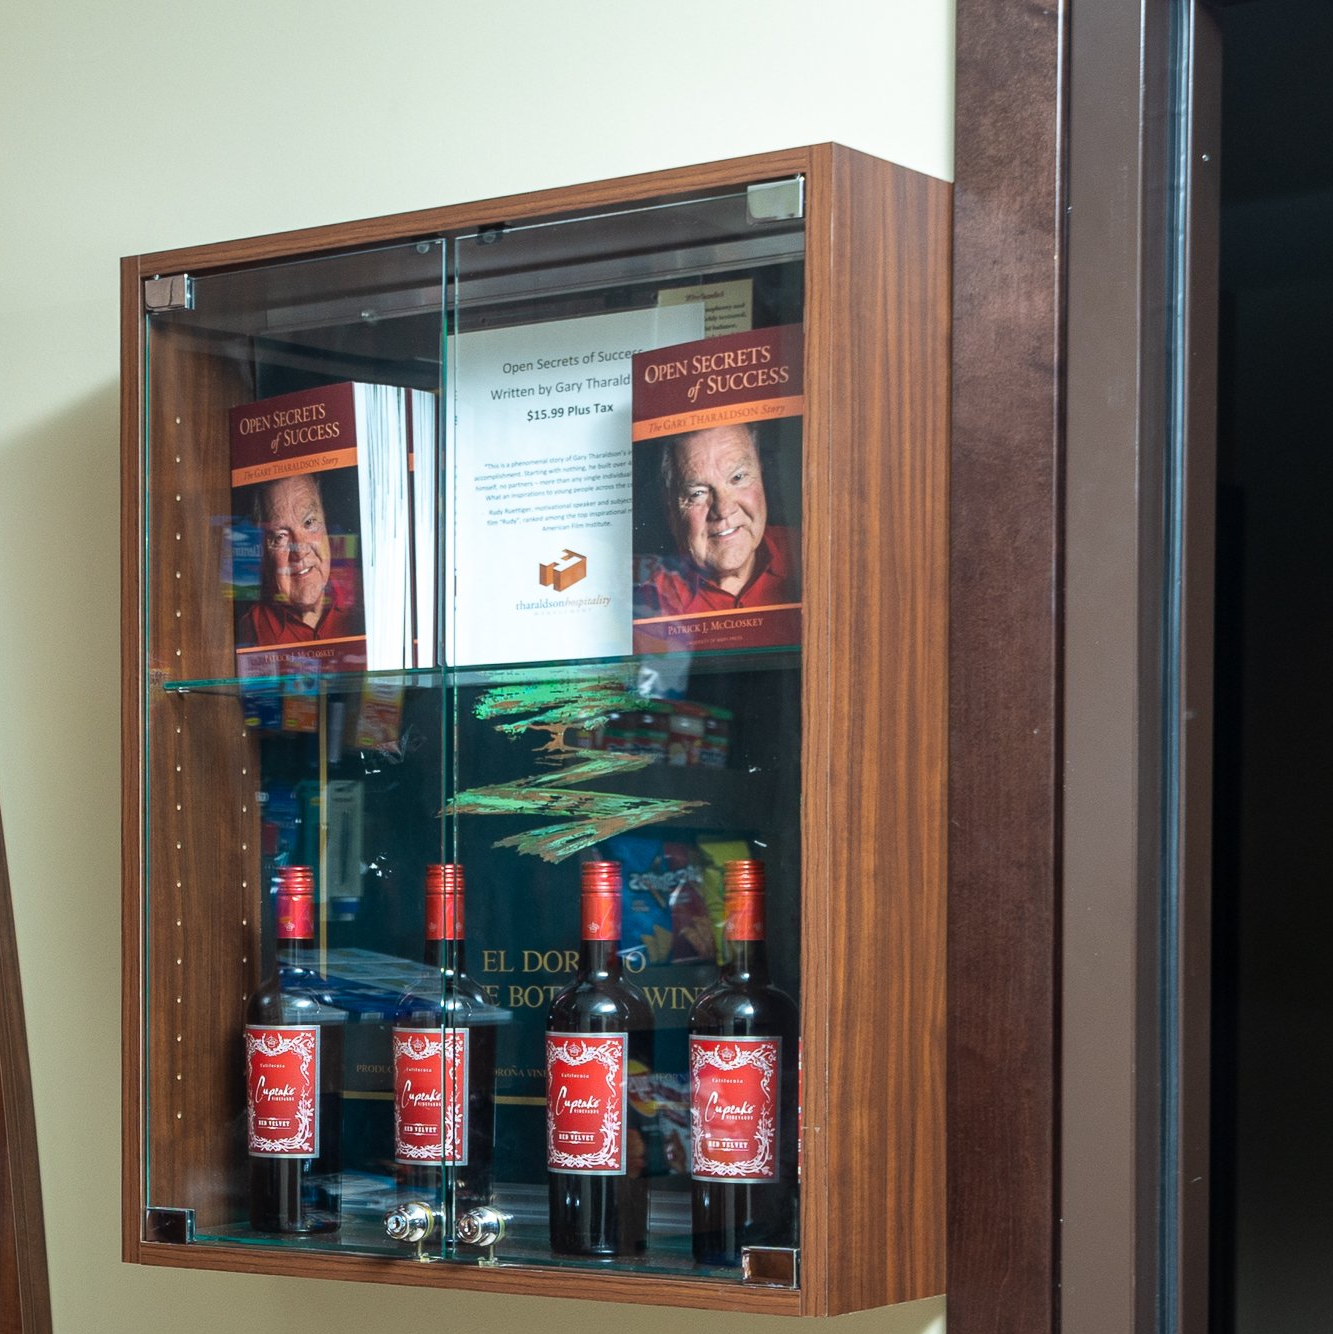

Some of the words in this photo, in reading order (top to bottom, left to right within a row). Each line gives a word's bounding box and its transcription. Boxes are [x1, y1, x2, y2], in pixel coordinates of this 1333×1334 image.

[502, 360, 534, 376] Open
[536, 355, 580, 371] Secrets
[582, 352, 596, 365] of
[644, 359, 689, 384] OPEN
[692, 345, 771, 375] SECRETS
[491, 385, 535, 401] Written
[538, 384, 553, 397] by
[555, 381, 584, 394] Gary
[586, 374, 631, 390] Tharald
[687, 378, 704, 403] of
[706, 366, 790, 395] SUCCESS
[239, 414, 271, 436] OPEN
[273, 403, 326, 429] SECRETS
[526, 407, 564, 422] $15.99
[567, 405, 591, 417] Plus
[593, 402, 614, 414] Tax
[648, 422, 662, 434] The
[663, 418, 687, 431] GARY
[689, 406, 759, 427] THARALDSON
[761, 403, 786, 417] Story
[270, 432, 282, 454] of
[283, 421, 340, 447] SUCCESS
[508, 481, 533, 490] partners
[571, 476, 582, 484] any
[583, 474, 601, 482] single
[602, 471, 631, 480] individual
[554, 487, 572, 496] young
[573, 485, 594, 494] people
[573, 501, 596, 510] speaker
[542, 524, 571, 532] American
[544, 514, 565, 522] among
[268, 1119, 290, 1127] VELVET
[558, 1133, 569, 1142] RED
[569, 1133, 595, 1142] VELVET
